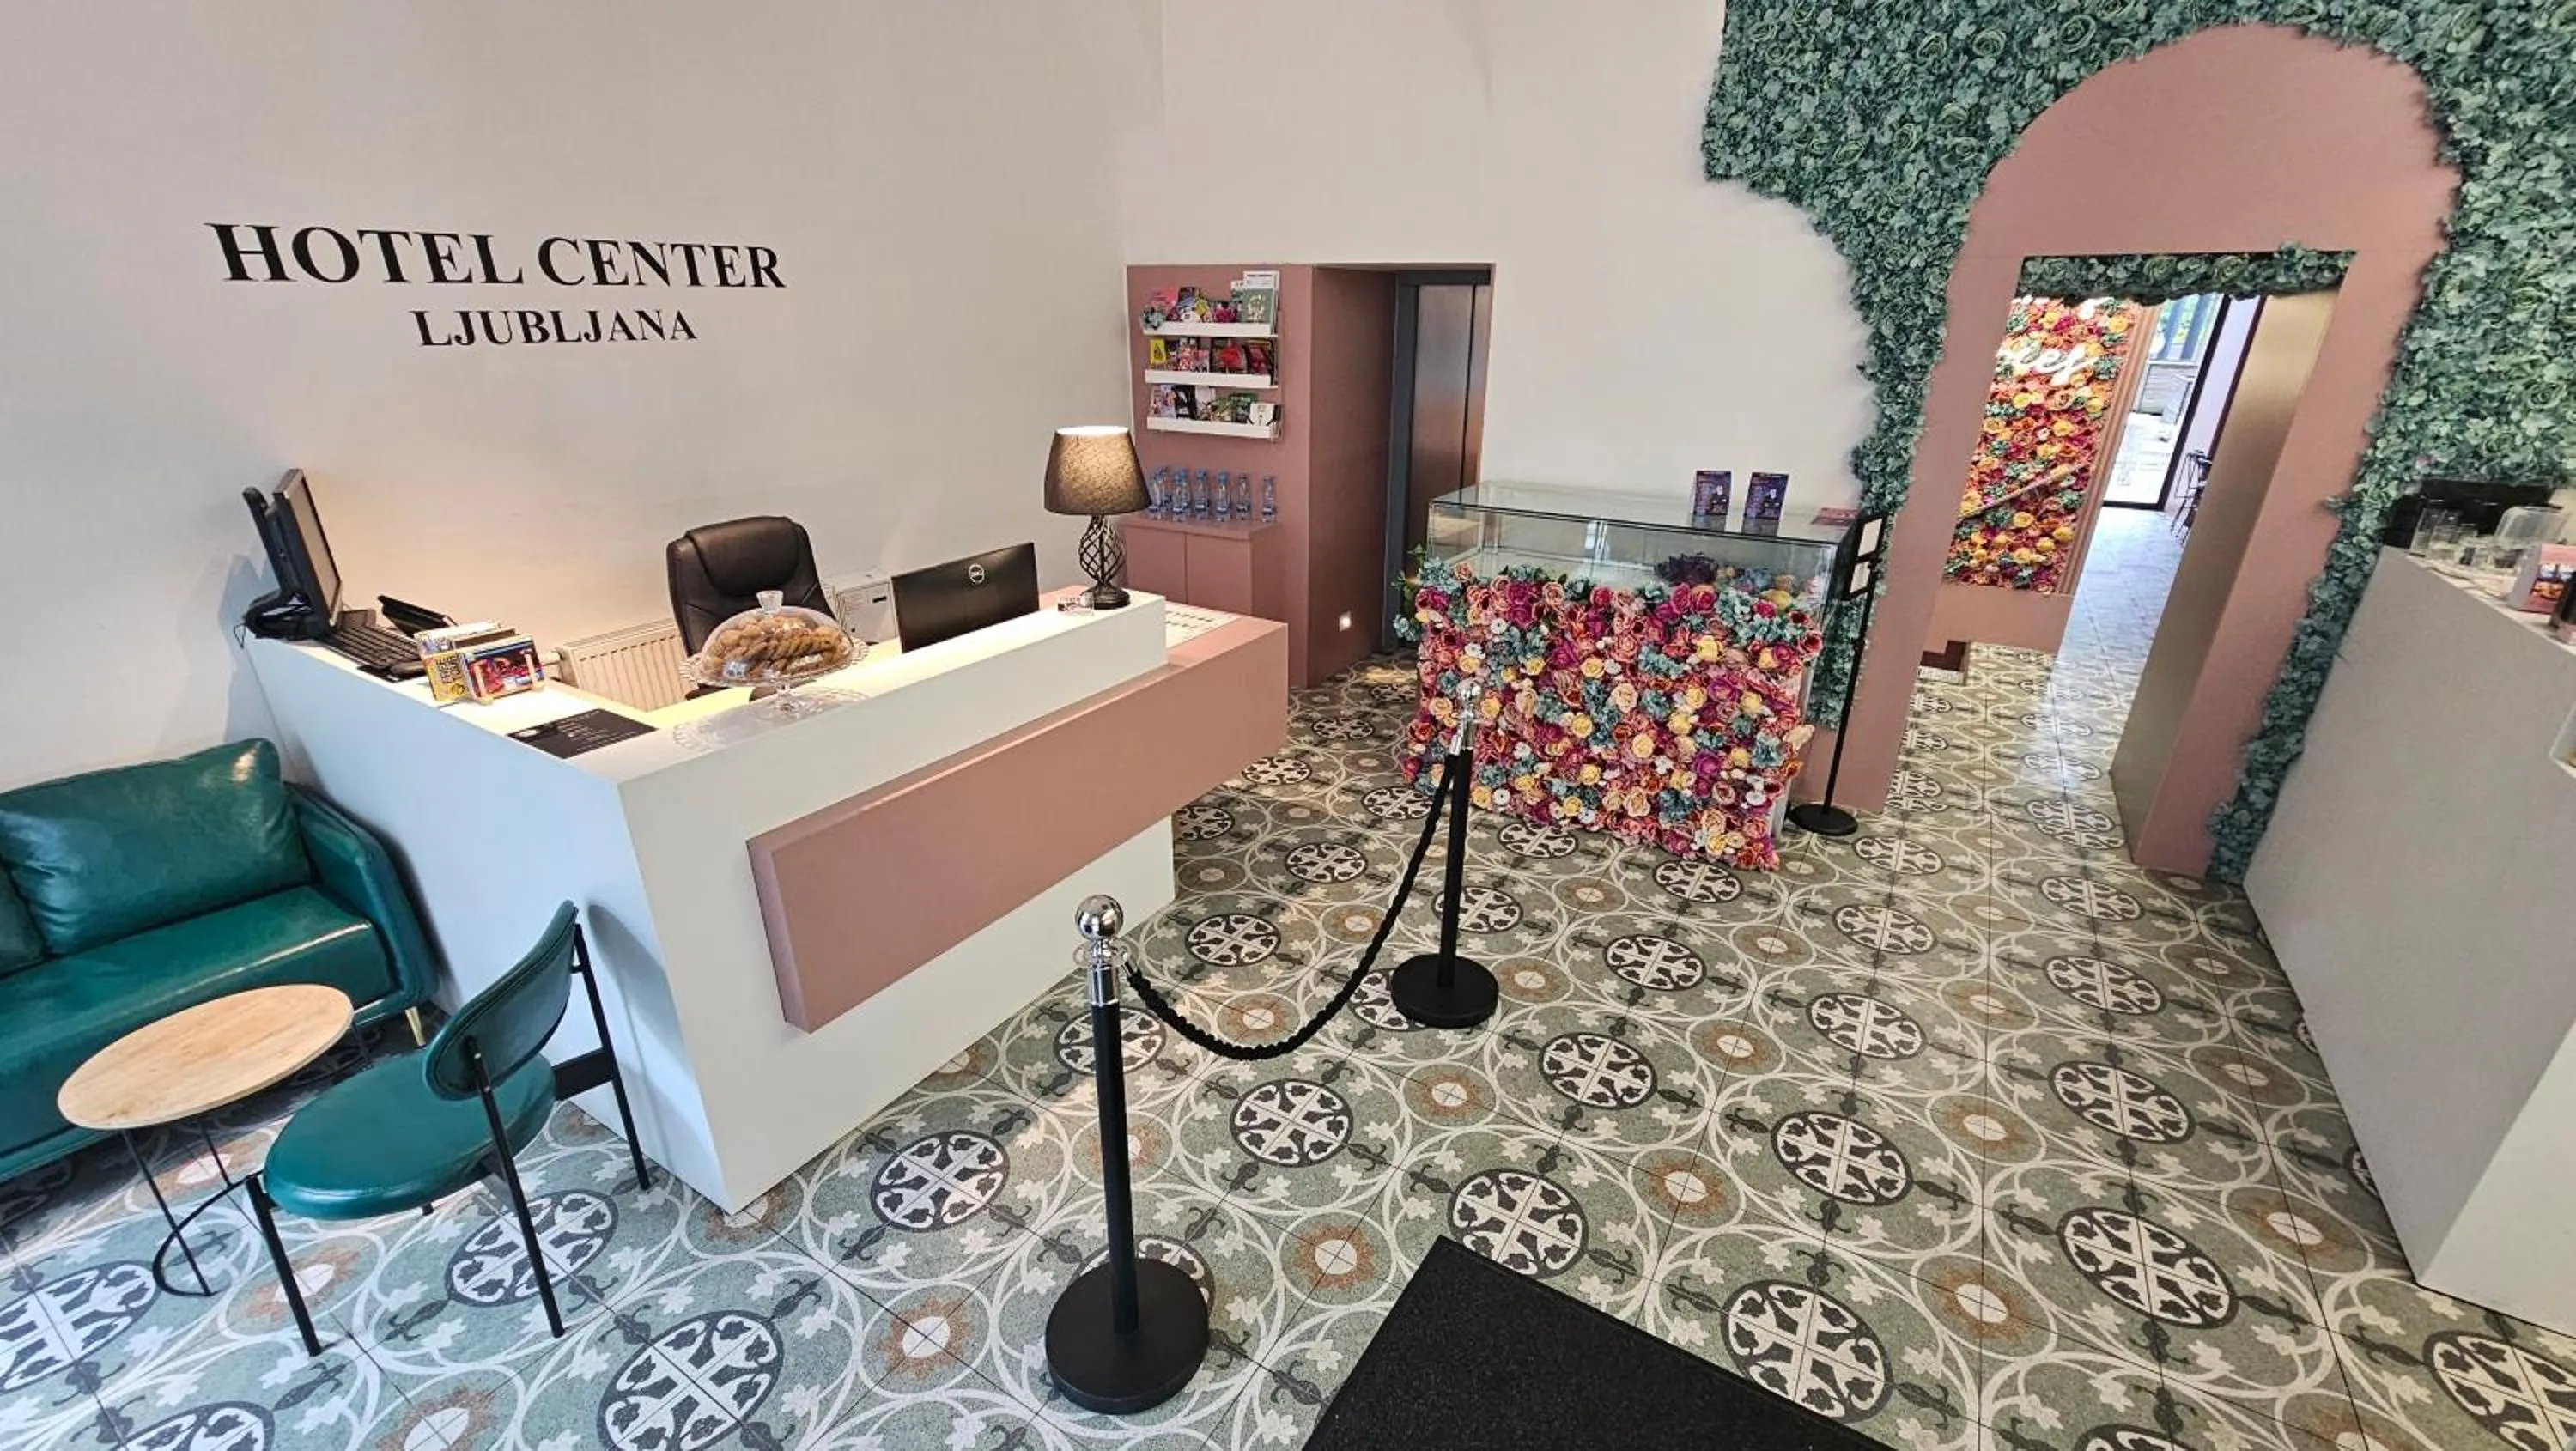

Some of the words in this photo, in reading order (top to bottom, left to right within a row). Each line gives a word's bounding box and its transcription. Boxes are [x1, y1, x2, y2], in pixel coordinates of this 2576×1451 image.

[204, 222, 524, 285] HOTEL
[537, 237, 787, 288] CENTER
[411, 309, 697, 347] LJUBLJANA
